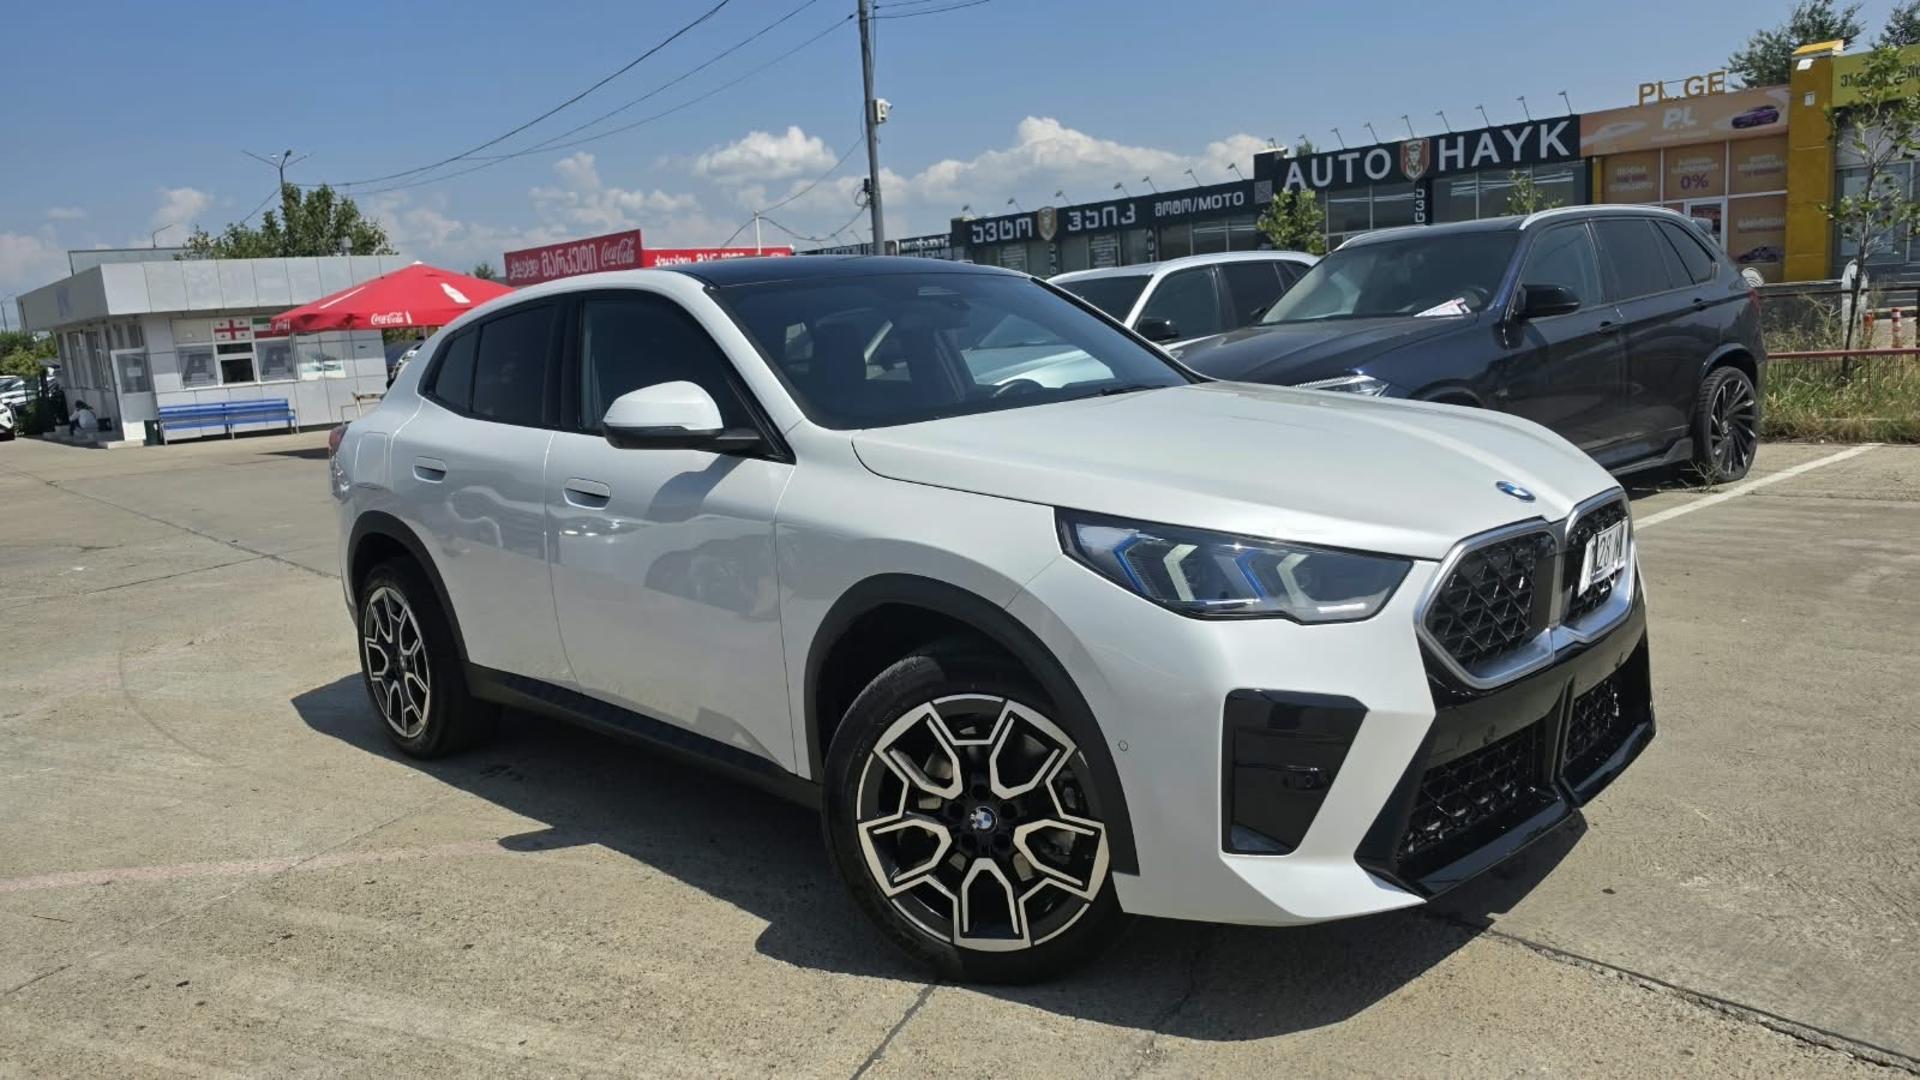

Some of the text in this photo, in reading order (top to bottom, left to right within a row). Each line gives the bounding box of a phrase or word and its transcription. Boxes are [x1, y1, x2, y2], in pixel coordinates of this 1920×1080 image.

[1284, 120, 1570, 190] AUTO HAYK
[1680, 173, 1709, 190] 0%
[971, 217, 1033, 243] ავტო
[1067, 203, 1136, 231] ჰაიკ
[541, 243, 598, 277] მარკეტი
